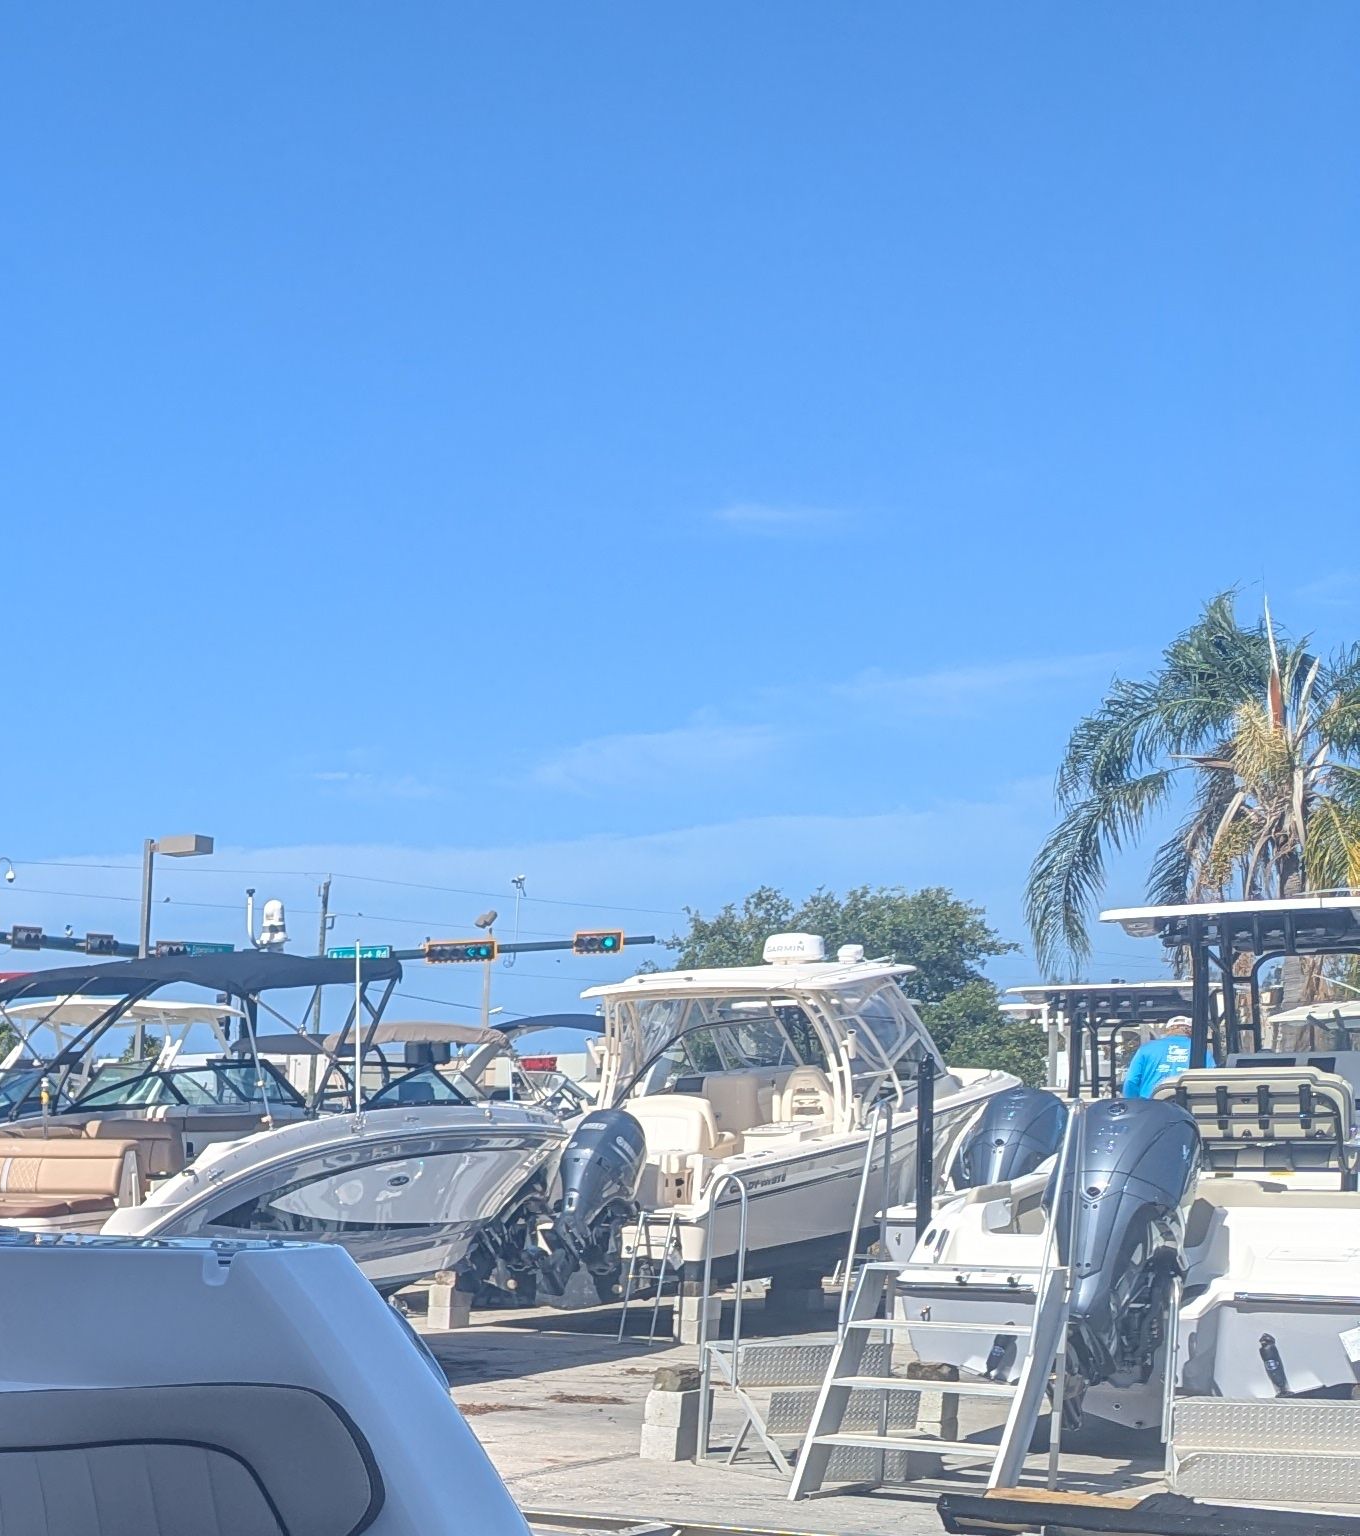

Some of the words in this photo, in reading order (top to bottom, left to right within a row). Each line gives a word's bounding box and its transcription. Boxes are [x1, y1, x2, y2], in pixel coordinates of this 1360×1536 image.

[767, 944, 805, 952] GARMIN
[332, 950, 373, 958] Airt
[729, 1172, 787, 1194] GDY-WHITE
